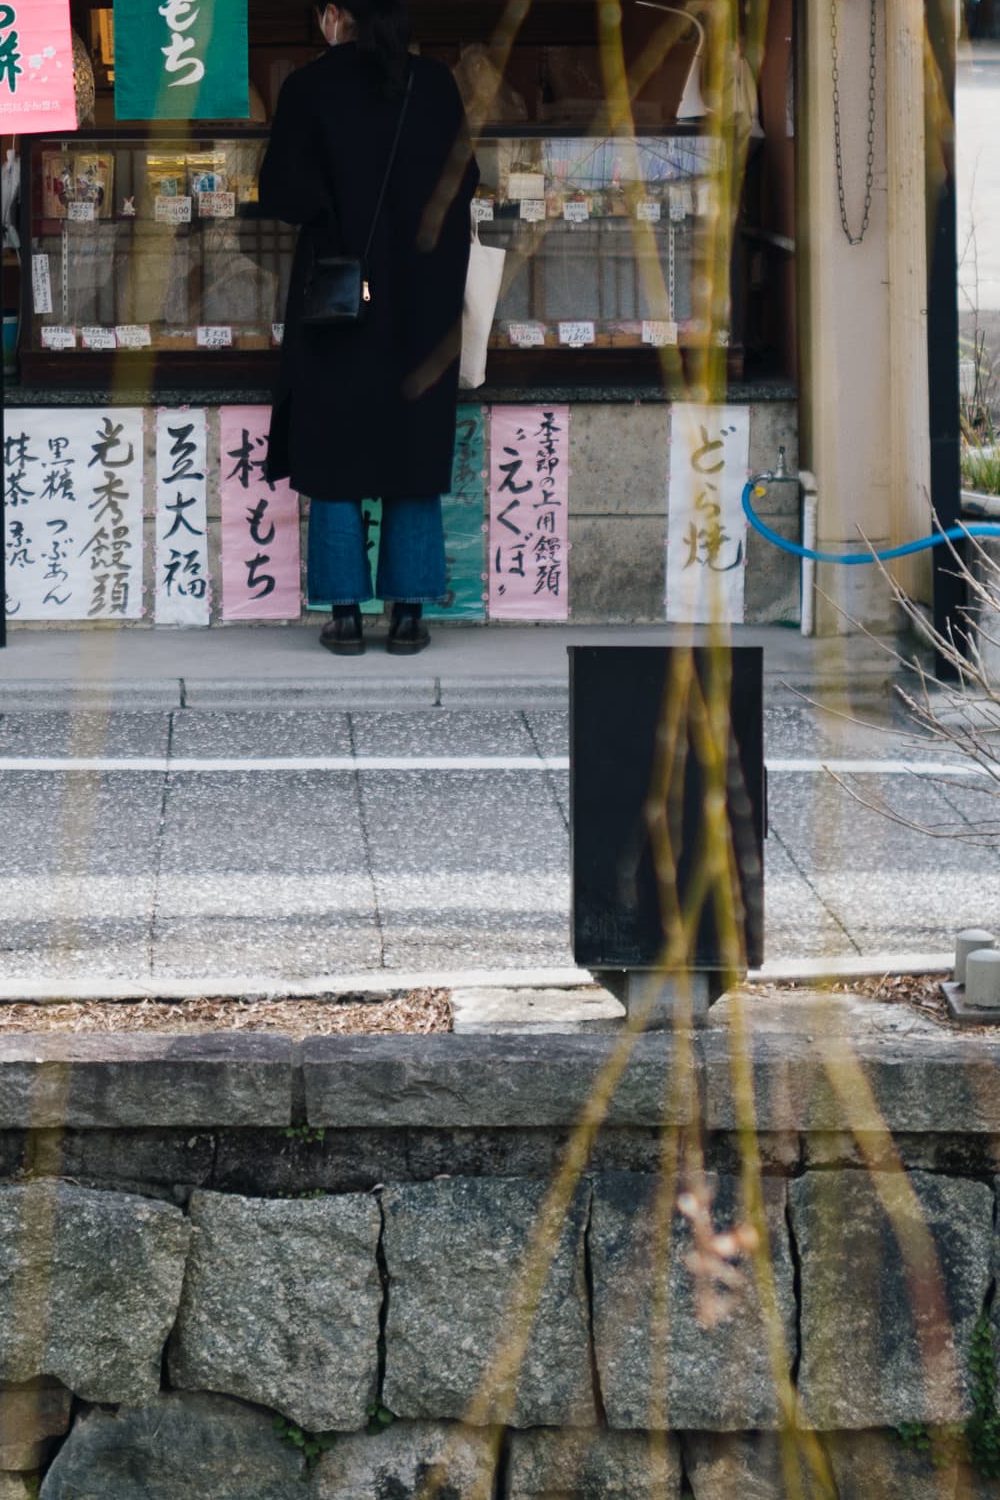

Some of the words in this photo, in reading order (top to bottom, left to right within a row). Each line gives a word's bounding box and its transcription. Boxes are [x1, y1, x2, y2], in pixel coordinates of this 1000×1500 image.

[40, 437, 76, 501] 黒糖
[78, 417, 135, 617] 光秀饅頭
[162, 424, 206, 599] 豆大福
[533, 412, 562, 597] 季節の上用饅頭
[683, 424, 743, 573] どら焼
[41, 519, 74, 605] つぶあん
